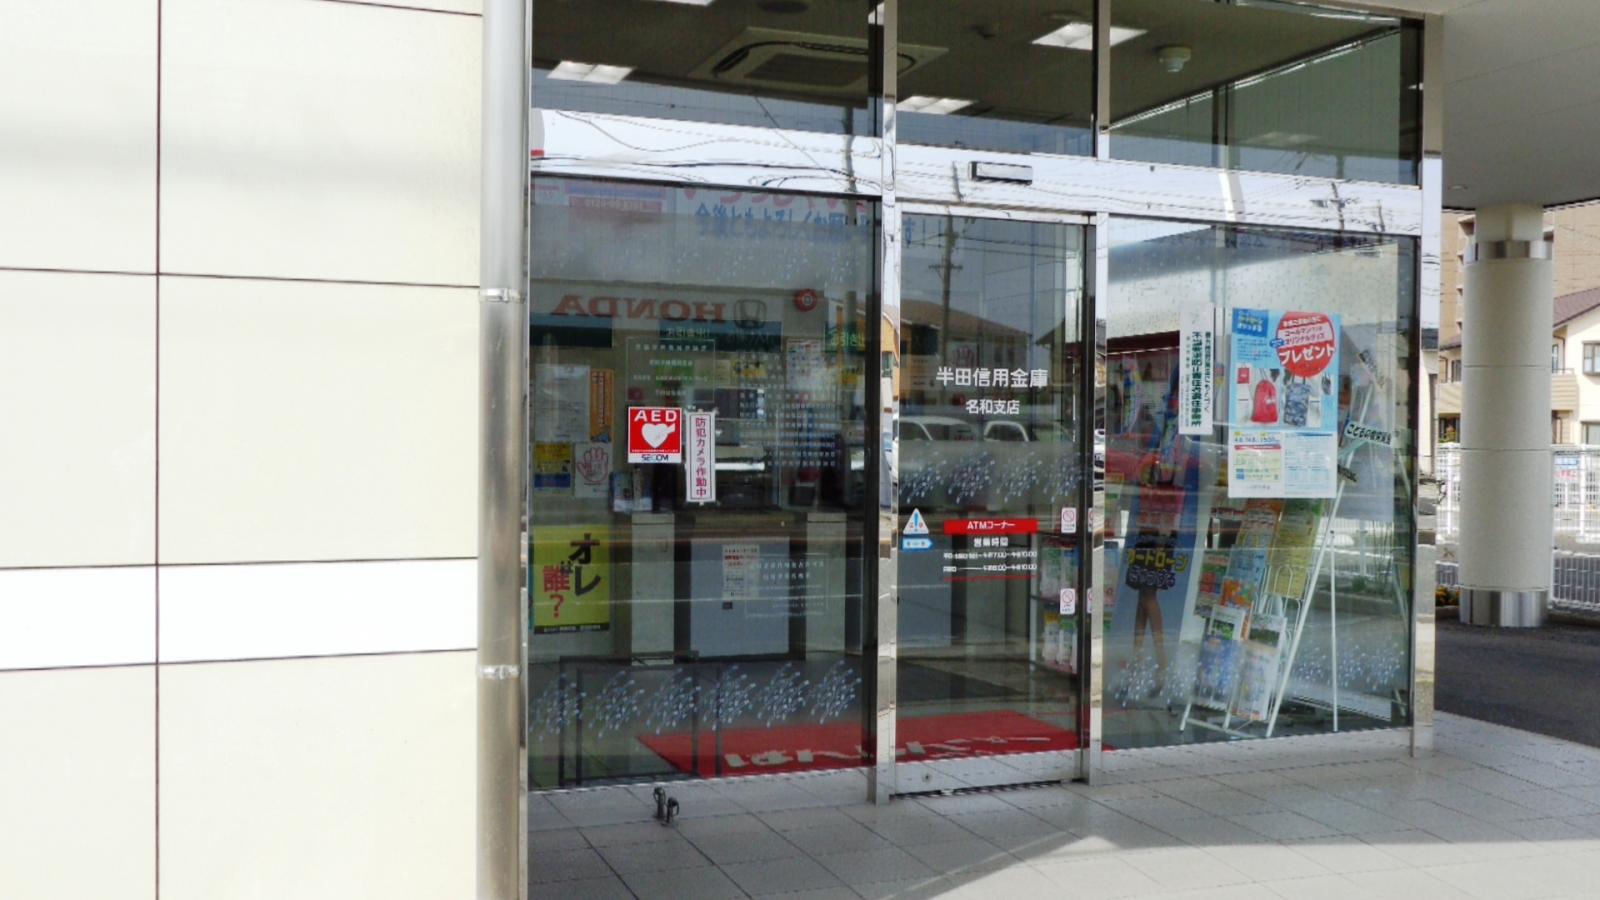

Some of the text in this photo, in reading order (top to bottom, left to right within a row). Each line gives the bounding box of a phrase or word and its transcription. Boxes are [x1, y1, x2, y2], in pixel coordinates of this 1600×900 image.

[1279, 344, 1336, 365] プレゼント
[936, 366, 1048, 388] 半田信用金庫
[966, 399, 1020, 415] 名和支店
[634, 410, 677, 422] AED
[641, 454, 669, 462] SECOM
[695, 417, 708, 497] 防犯カメラ作動中
[967, 520, 1016, 530] ATMコーナー
[974, 536, 1009, 548] 営業時間
[569, 533, 602, 596] オレ
